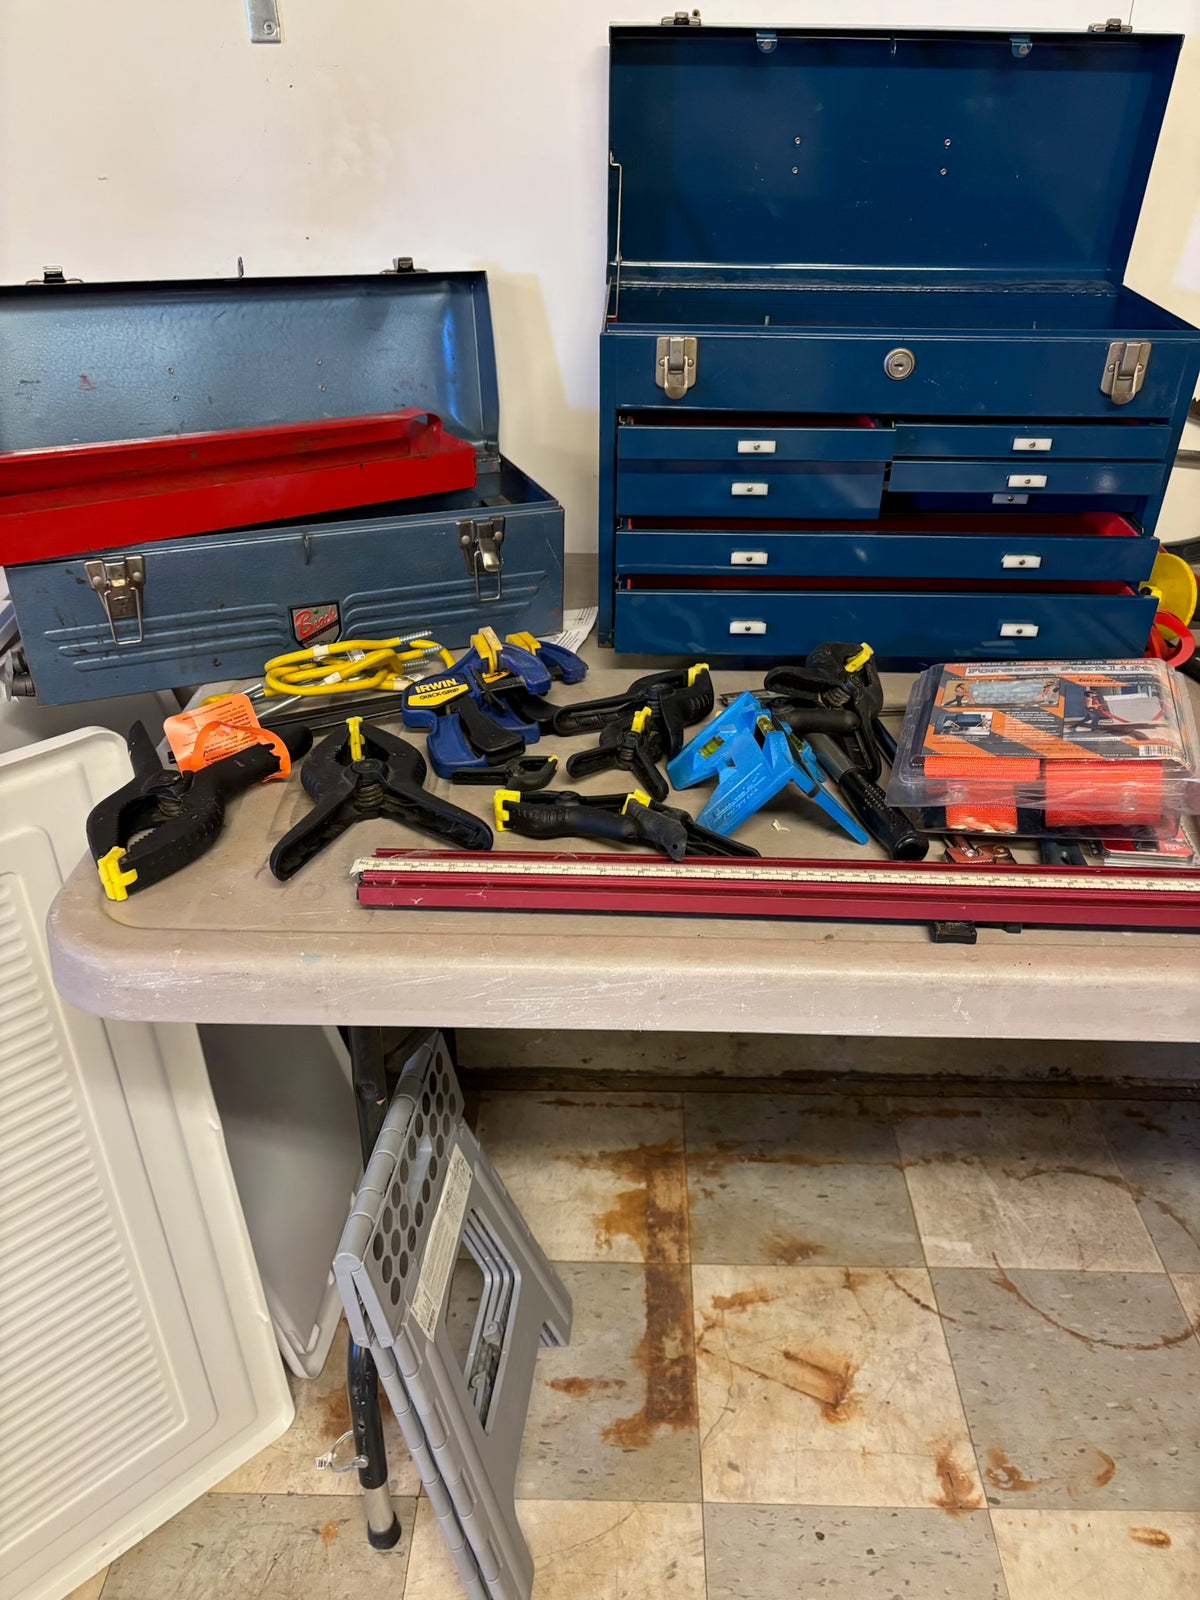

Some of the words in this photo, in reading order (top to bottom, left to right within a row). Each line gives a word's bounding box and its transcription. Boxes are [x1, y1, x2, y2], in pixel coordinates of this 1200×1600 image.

[294, 606, 338, 638] Beach
[414, 678, 458, 693] IRWIN
[419, 687, 460, 700] QUICK-GRIP
